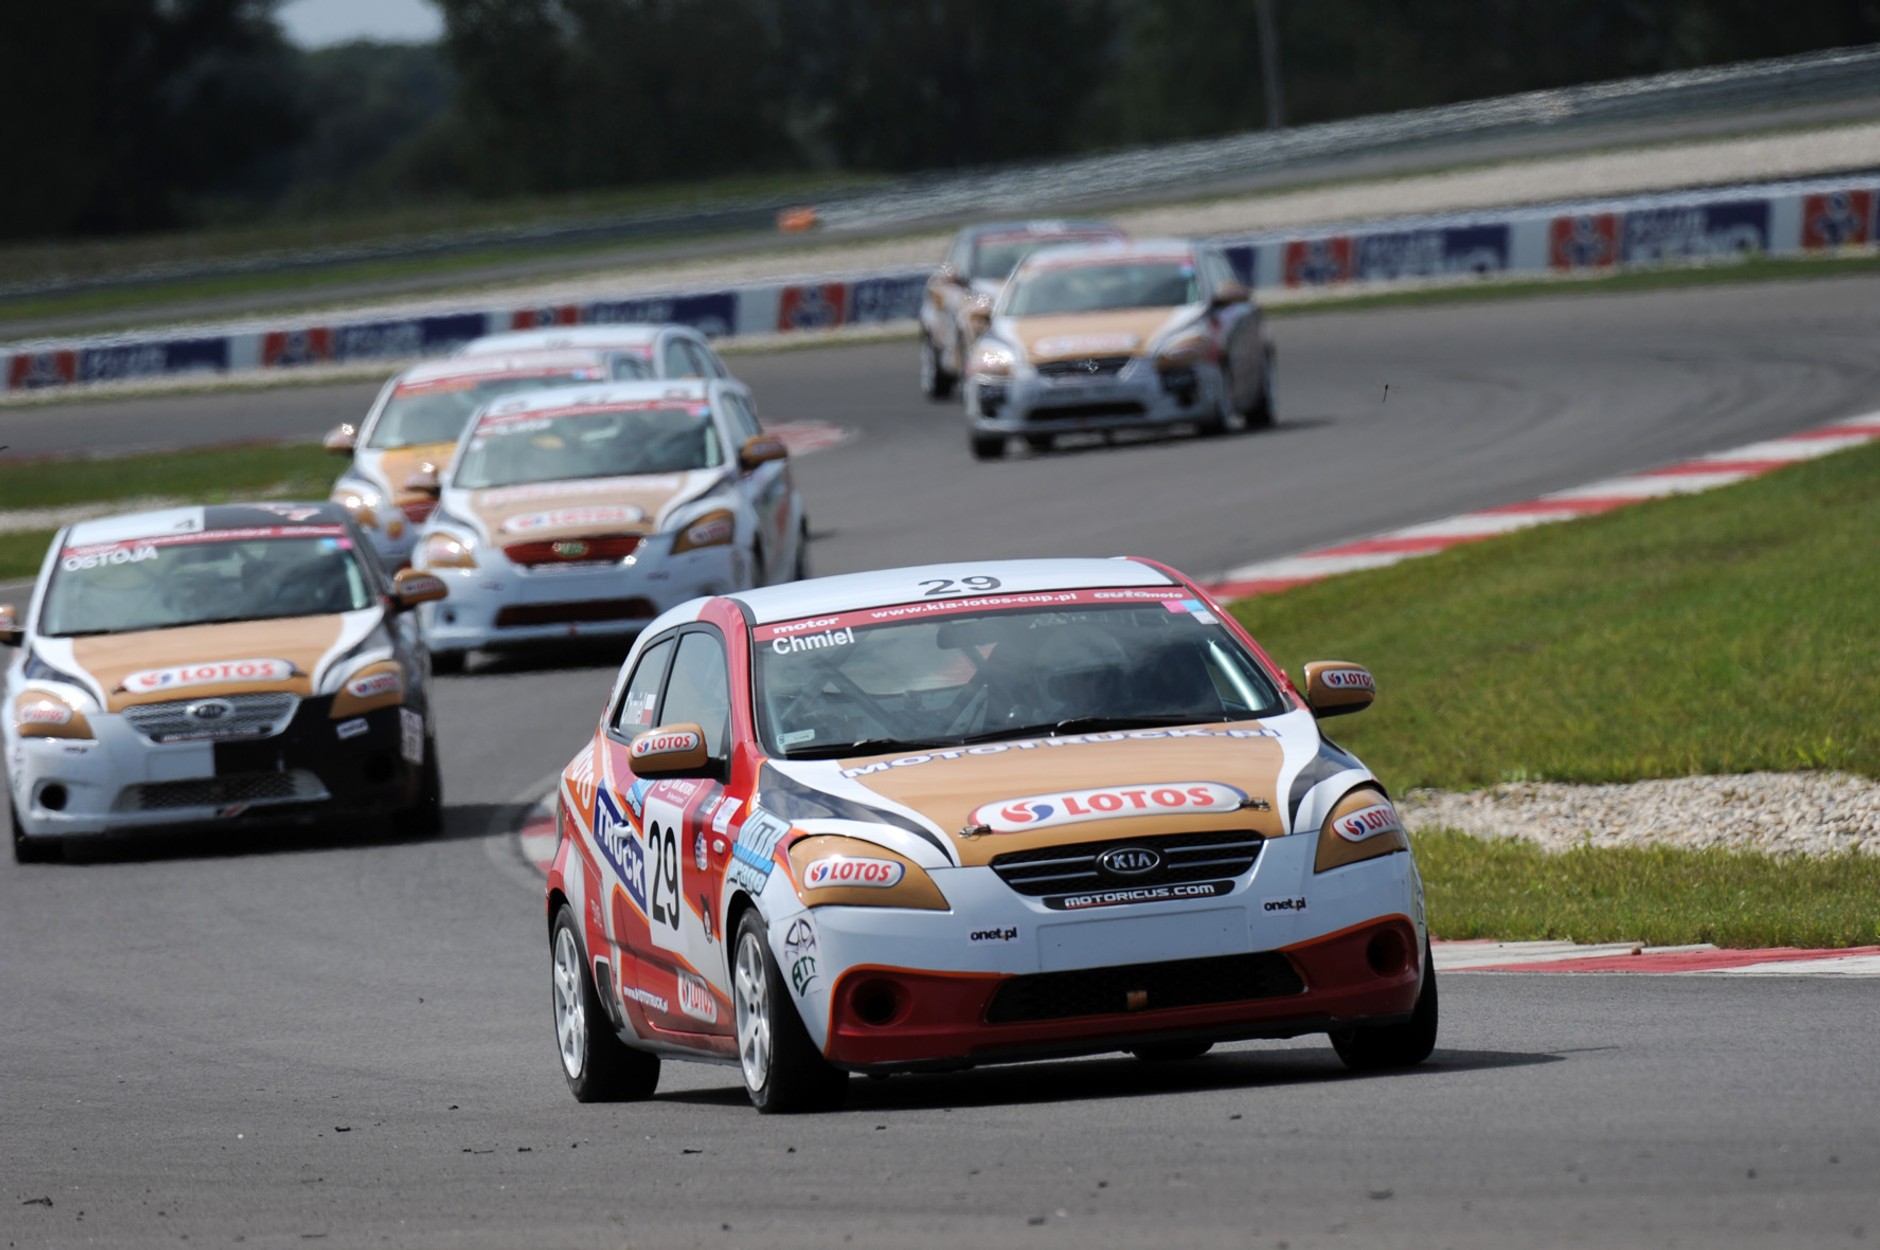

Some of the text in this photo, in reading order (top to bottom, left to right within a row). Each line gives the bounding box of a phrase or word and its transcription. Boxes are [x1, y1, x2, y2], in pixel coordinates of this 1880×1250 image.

[63, 545, 159, 571] OSTOJA
[918, 576, 1002, 596] 29
[773, 617, 840, 635] motor
[871, 593, 1077, 619] www.kia-lotos-cup.pl
[772, 626, 856, 656] Chmiel
[180, 662, 275, 682] LOTOS
[651, 735, 691, 750] LOTOS
[1062, 787, 1216, 816] LOTOS
[829, 862, 892, 882] LOTOS
[1112, 853, 1150, 871] KIA
[648, 820, 679, 931] 29
[1064, 884, 1216, 909] MOTORICUS.COM
[1263, 897, 1307, 912] onet.pl
[970, 926, 1018, 943] onet.pl
